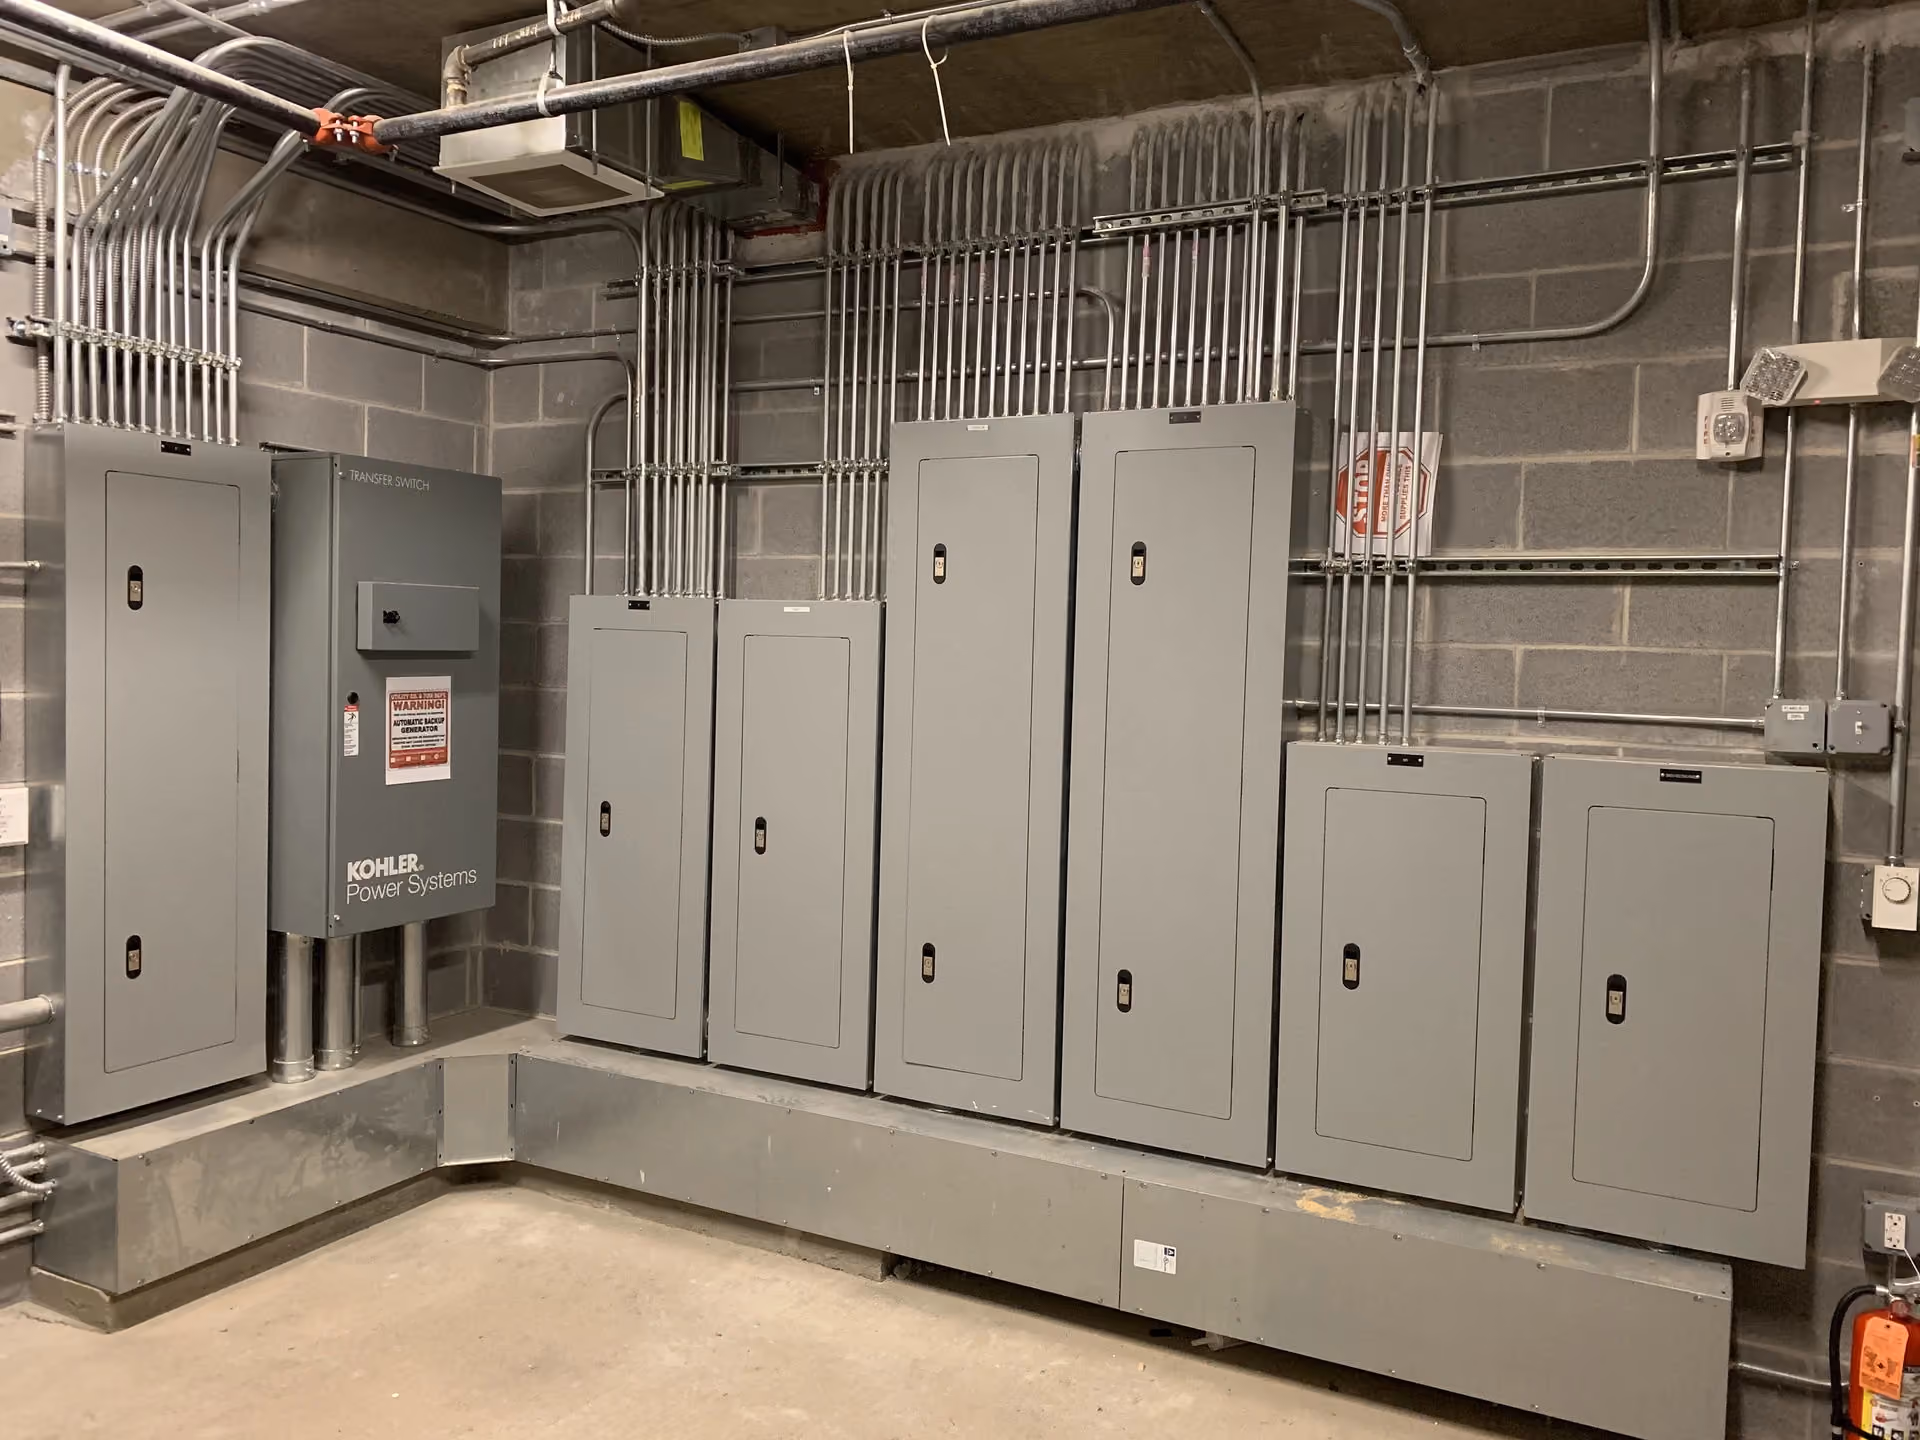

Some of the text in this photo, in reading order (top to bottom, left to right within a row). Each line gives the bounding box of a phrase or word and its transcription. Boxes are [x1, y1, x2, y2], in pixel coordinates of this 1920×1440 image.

[349, 469, 430, 491] TRANSFER SWITCH
[1403, 465, 1412, 482] THIS
[1381, 501, 1389, 522] MORE
[1399, 484, 1409, 520] SUPPLIES
[393, 700, 445, 711] WARNING!
[393, 717, 445, 727] AUTOMATIC BACKUP
[400, 725, 438, 733] GENERATOR
[346, 869, 477, 905] Power Systems
